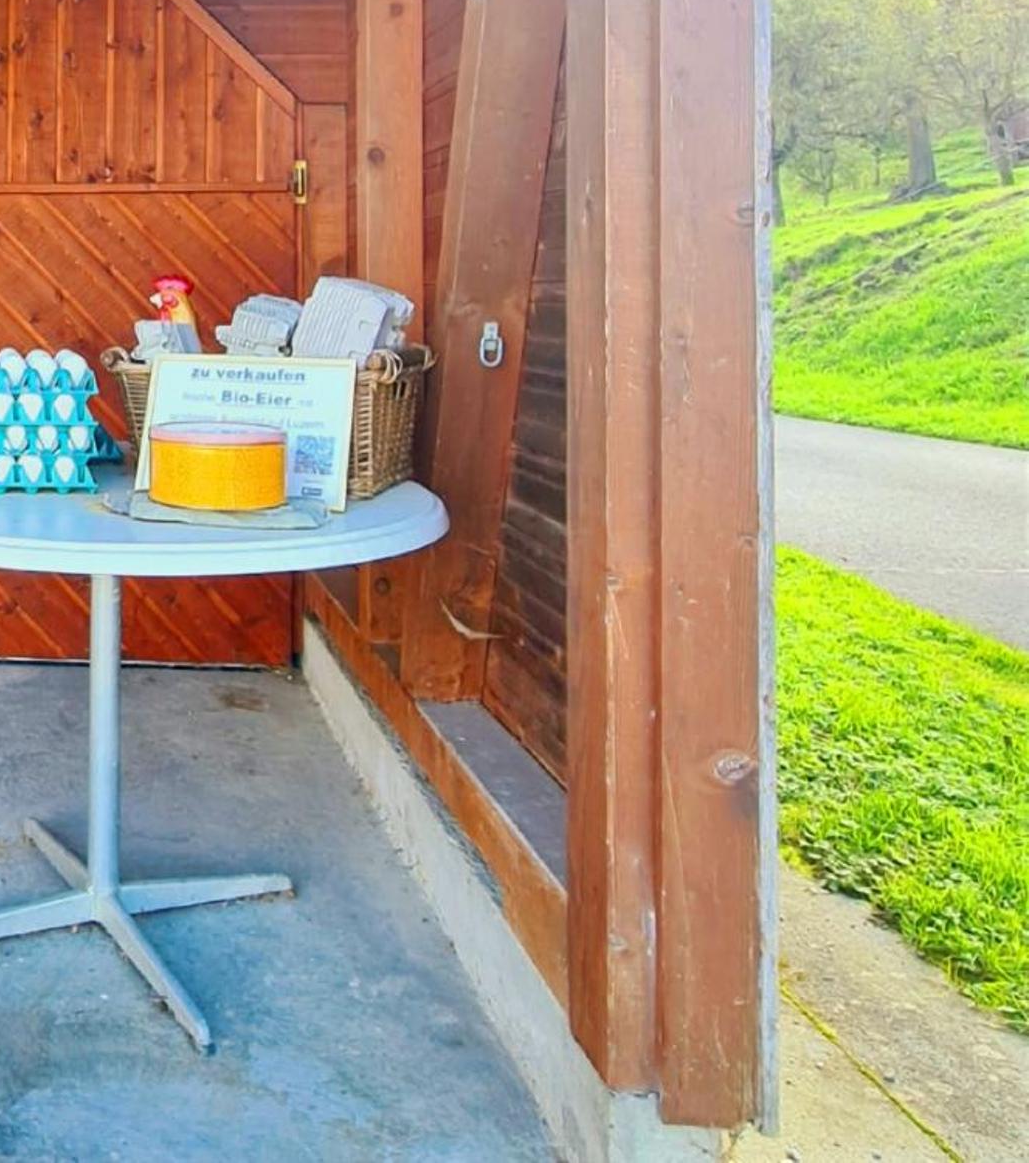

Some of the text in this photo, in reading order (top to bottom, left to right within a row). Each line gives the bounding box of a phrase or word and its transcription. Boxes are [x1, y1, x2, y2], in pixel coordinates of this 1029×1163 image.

[190, 367, 306, 382] zu verkaufen
[220, 389, 292, 407] Bio-Eier
